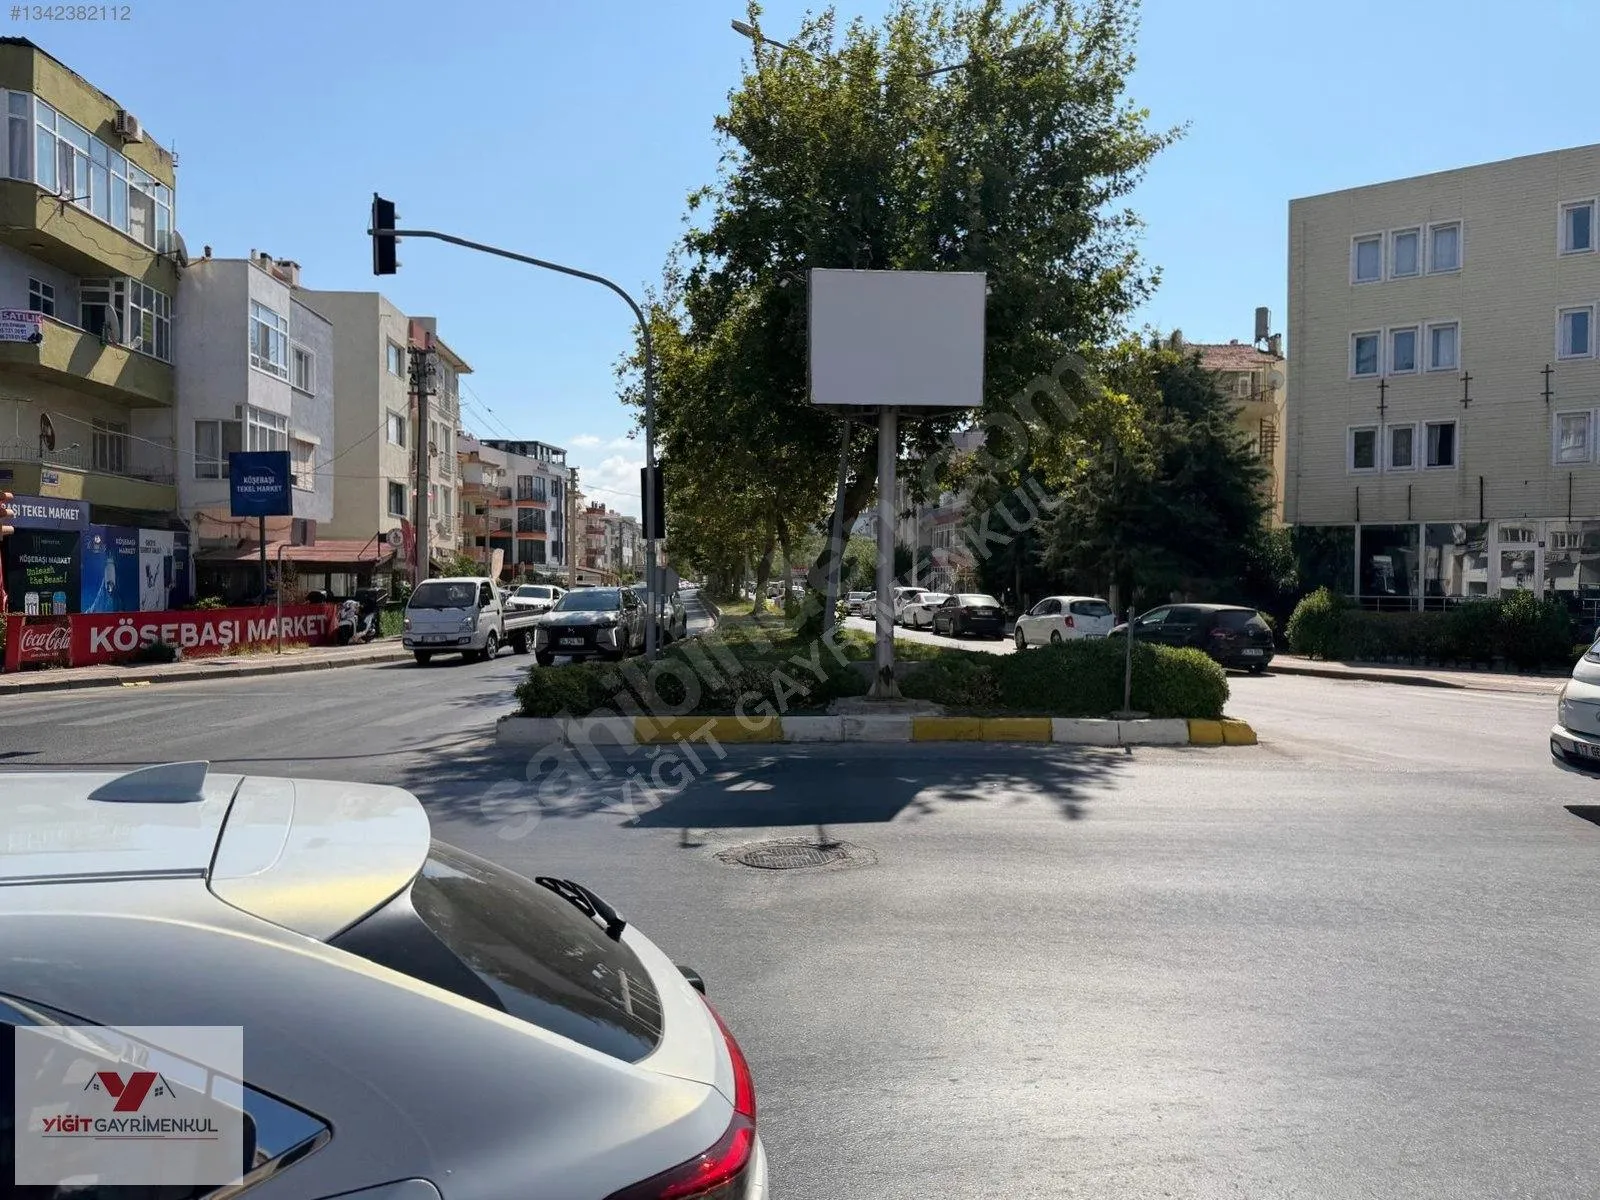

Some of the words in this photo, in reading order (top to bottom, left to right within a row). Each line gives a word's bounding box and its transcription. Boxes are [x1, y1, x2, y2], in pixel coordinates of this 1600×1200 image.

[3, 311, 43, 323] SATILIK
[243, 475, 275, 485] KÖŞEBAŞI
[237, 485, 256, 493] TEKEL
[257, 485, 282, 493] MARKET
[22, 504, 47, 518] TEKEL
[48, 507, 80, 520] MARKET
[248, 613, 327, 643] MARKET
